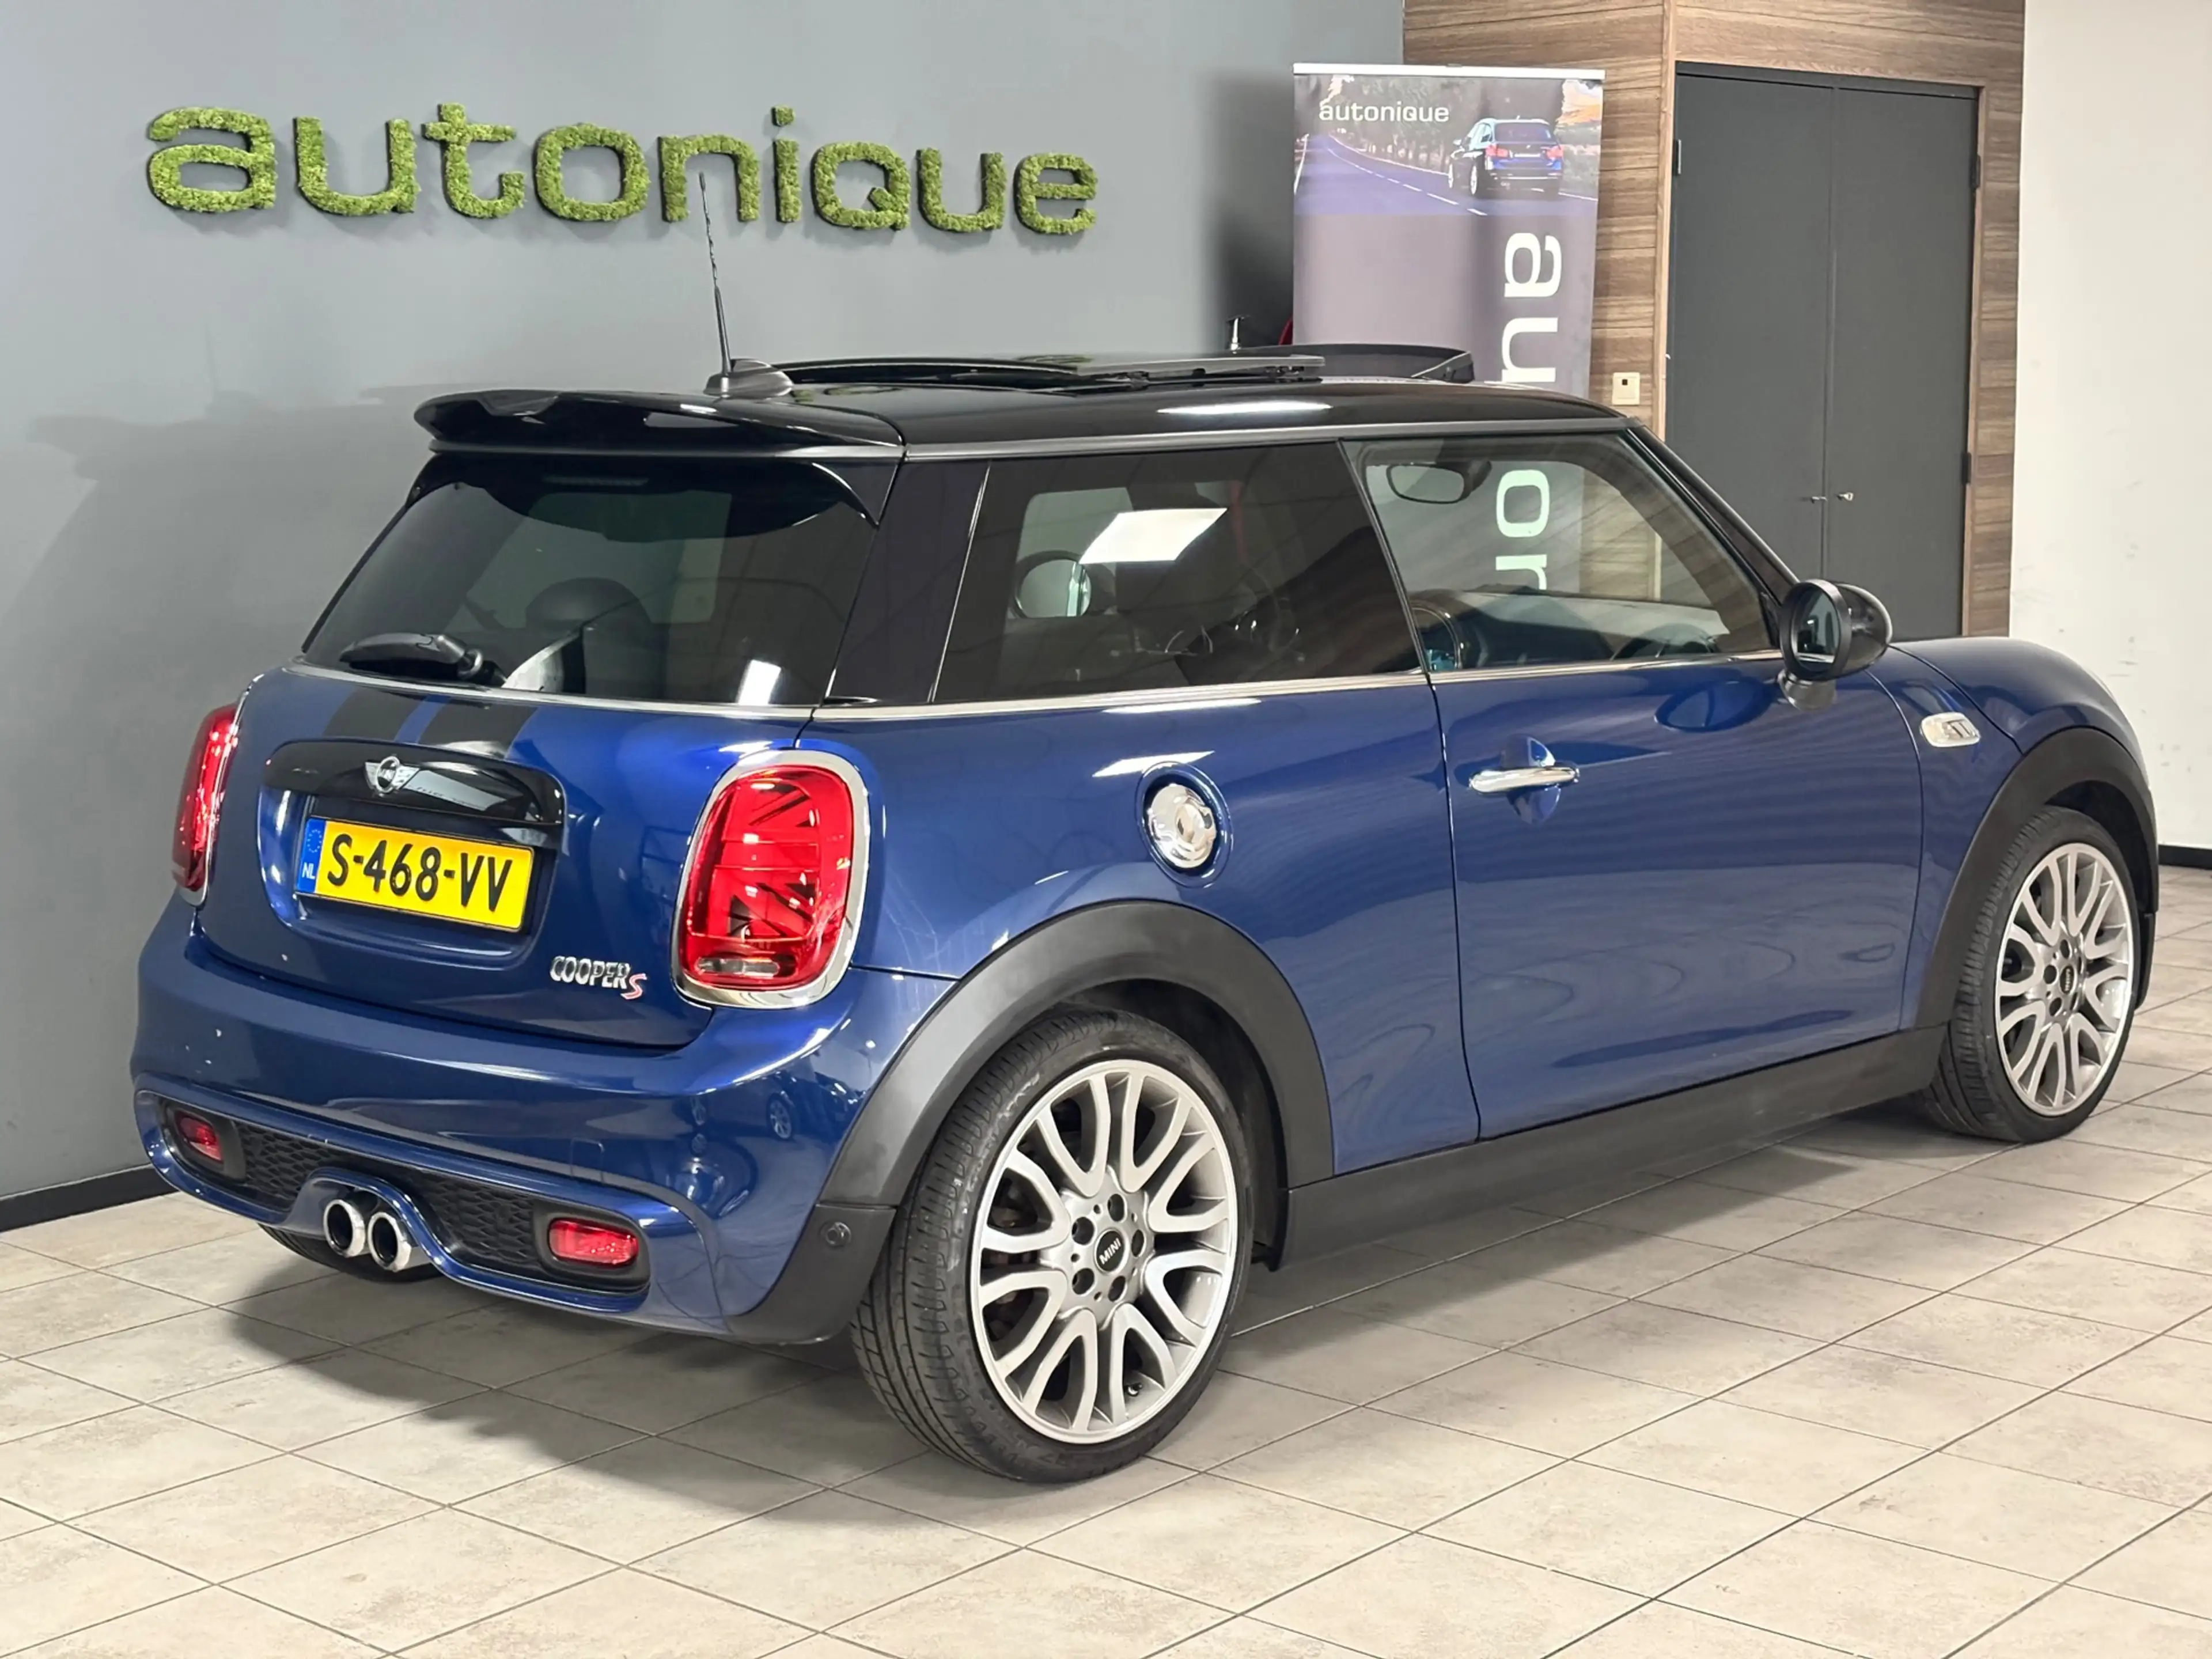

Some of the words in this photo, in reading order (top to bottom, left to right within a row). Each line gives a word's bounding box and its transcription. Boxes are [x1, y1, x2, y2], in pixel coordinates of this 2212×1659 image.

[1319, 101, 1449, 122] autonique
[147, 100, 1099, 235] autonique
[302, 862, 316, 880] NL
[328, 834, 513, 912] S-468-VV
[1099, 1237, 1122, 1265] MINI
